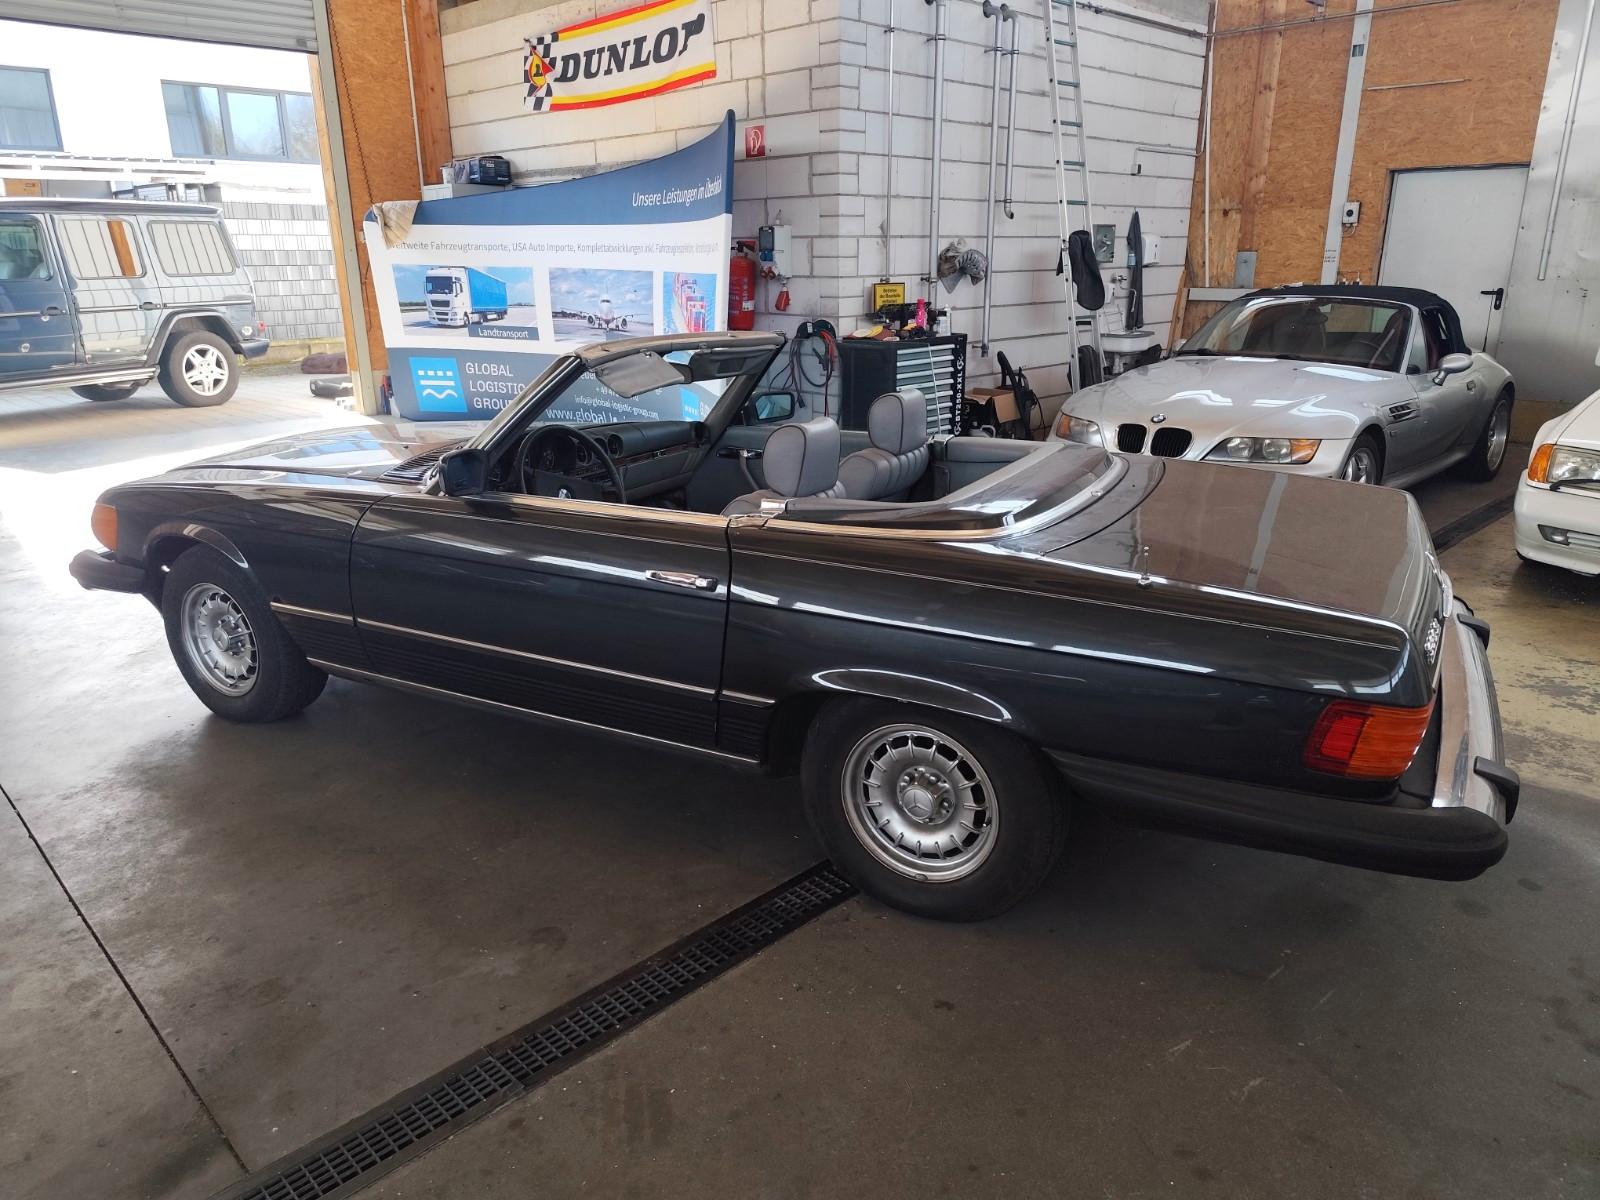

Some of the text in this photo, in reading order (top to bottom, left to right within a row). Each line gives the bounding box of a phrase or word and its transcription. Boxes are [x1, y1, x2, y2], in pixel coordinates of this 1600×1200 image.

[553, 12, 706, 83] DUNLOP
[632, 191, 662, 207] Unsere
[662, 186, 698, 207] Leistungen
[430, 240, 511, 253] Fahrzeugtransporte,
[512, 242, 527, 251] USA
[528, 242, 545, 251] Auto
[546, 242, 576, 253] Importe,
[478, 327, 529, 340] Landtransport
[465, 362, 514, 377] GLOBAL
